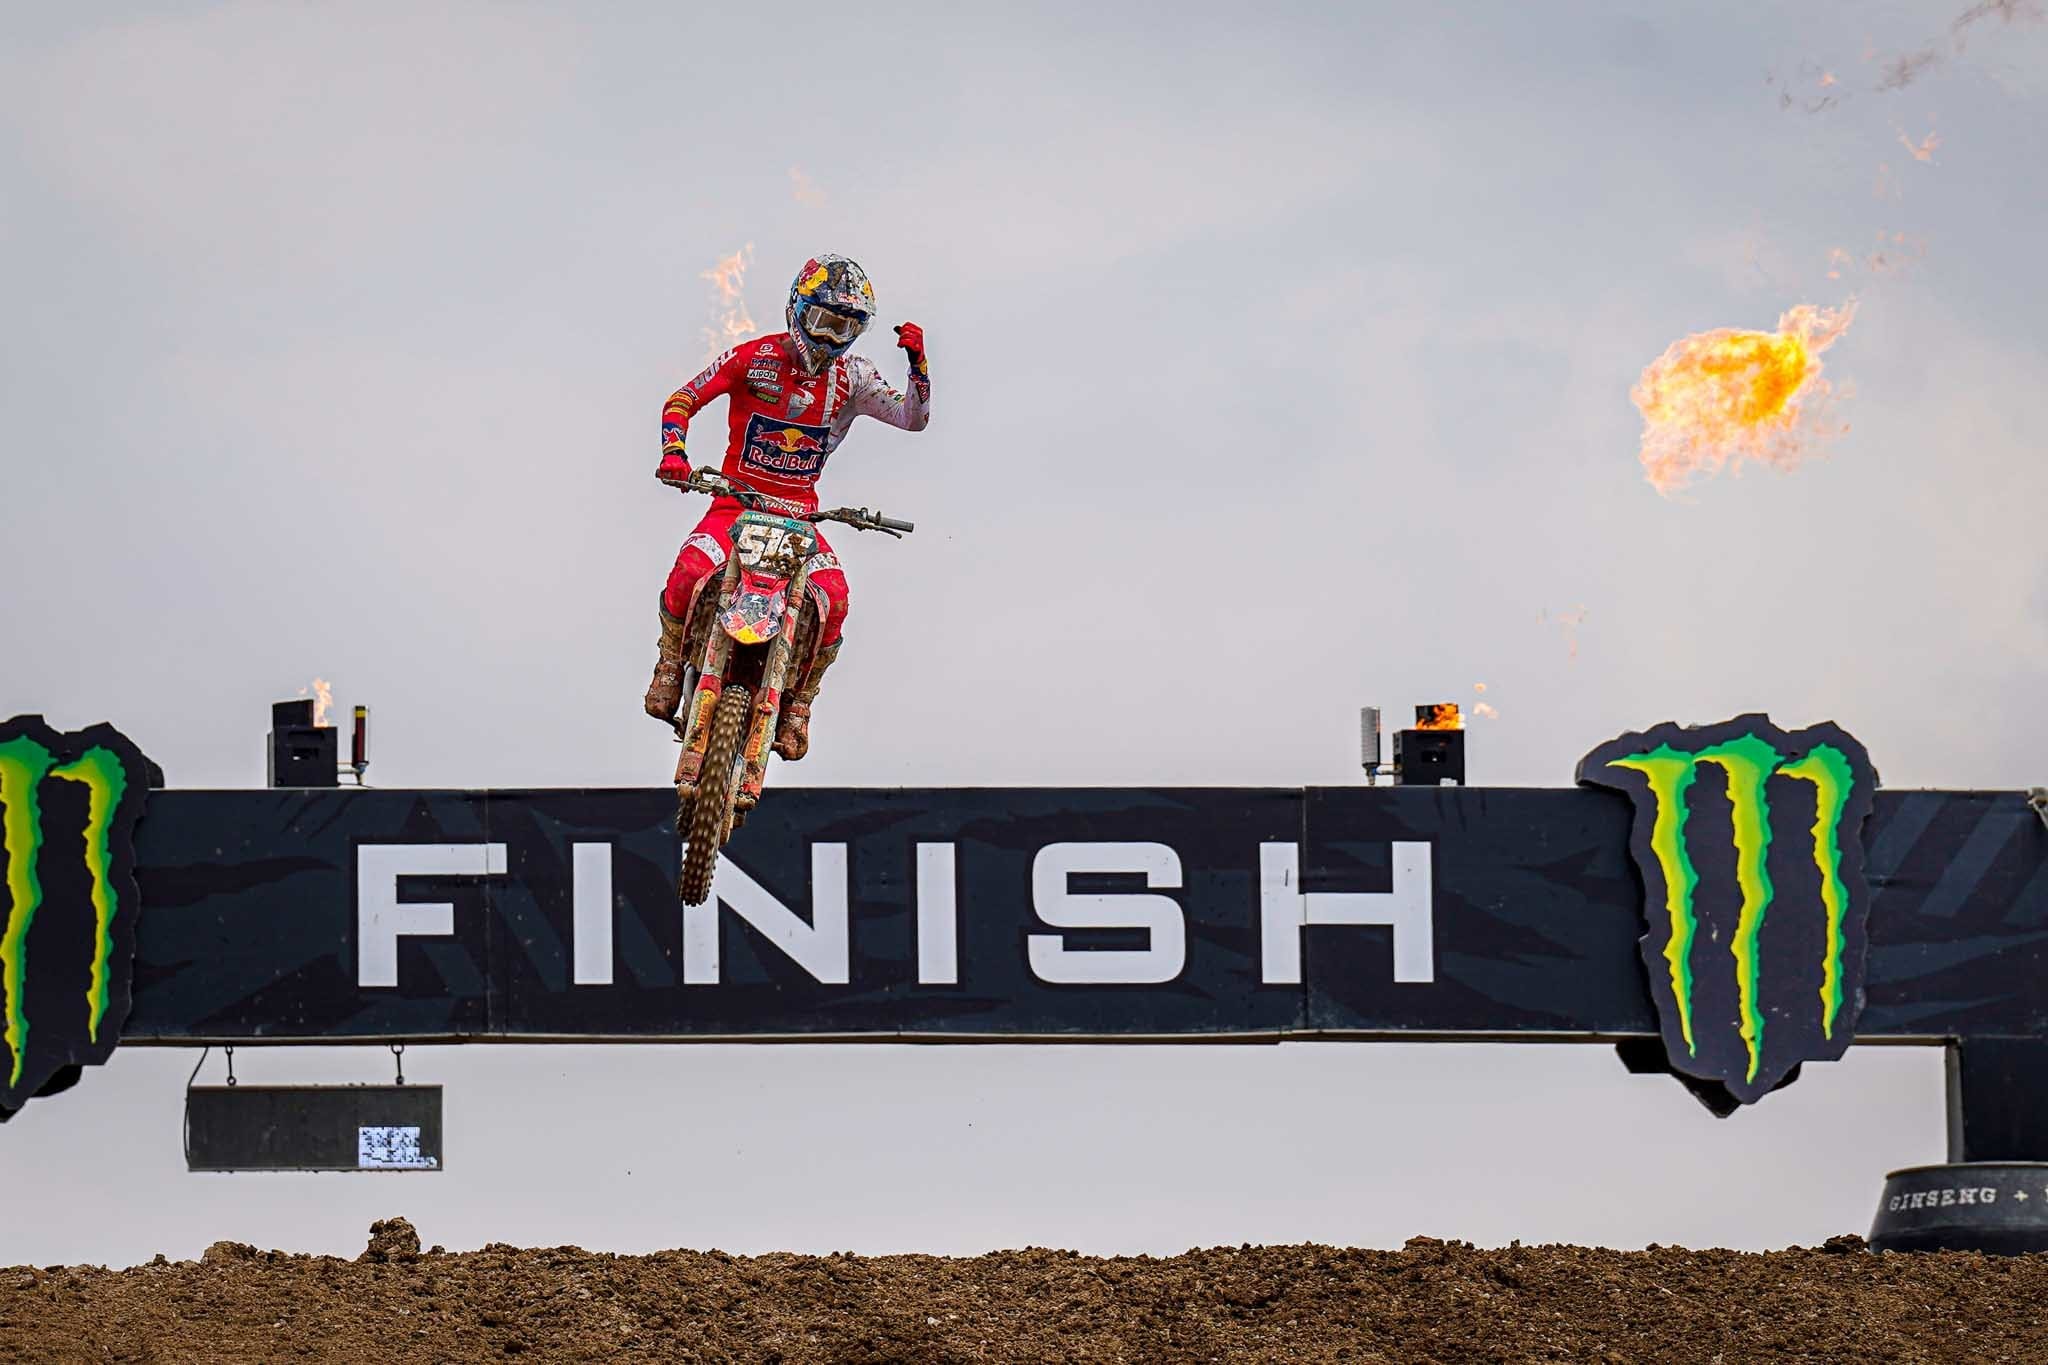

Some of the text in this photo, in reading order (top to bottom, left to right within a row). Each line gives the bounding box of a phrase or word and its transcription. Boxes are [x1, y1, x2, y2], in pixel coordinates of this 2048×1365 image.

[748, 445, 788, 469] Red
[785, 453, 821, 471] Bull
[357, 840, 1434, 987] FINISH
[1888, 1186, 1998, 1212] GINSENG
